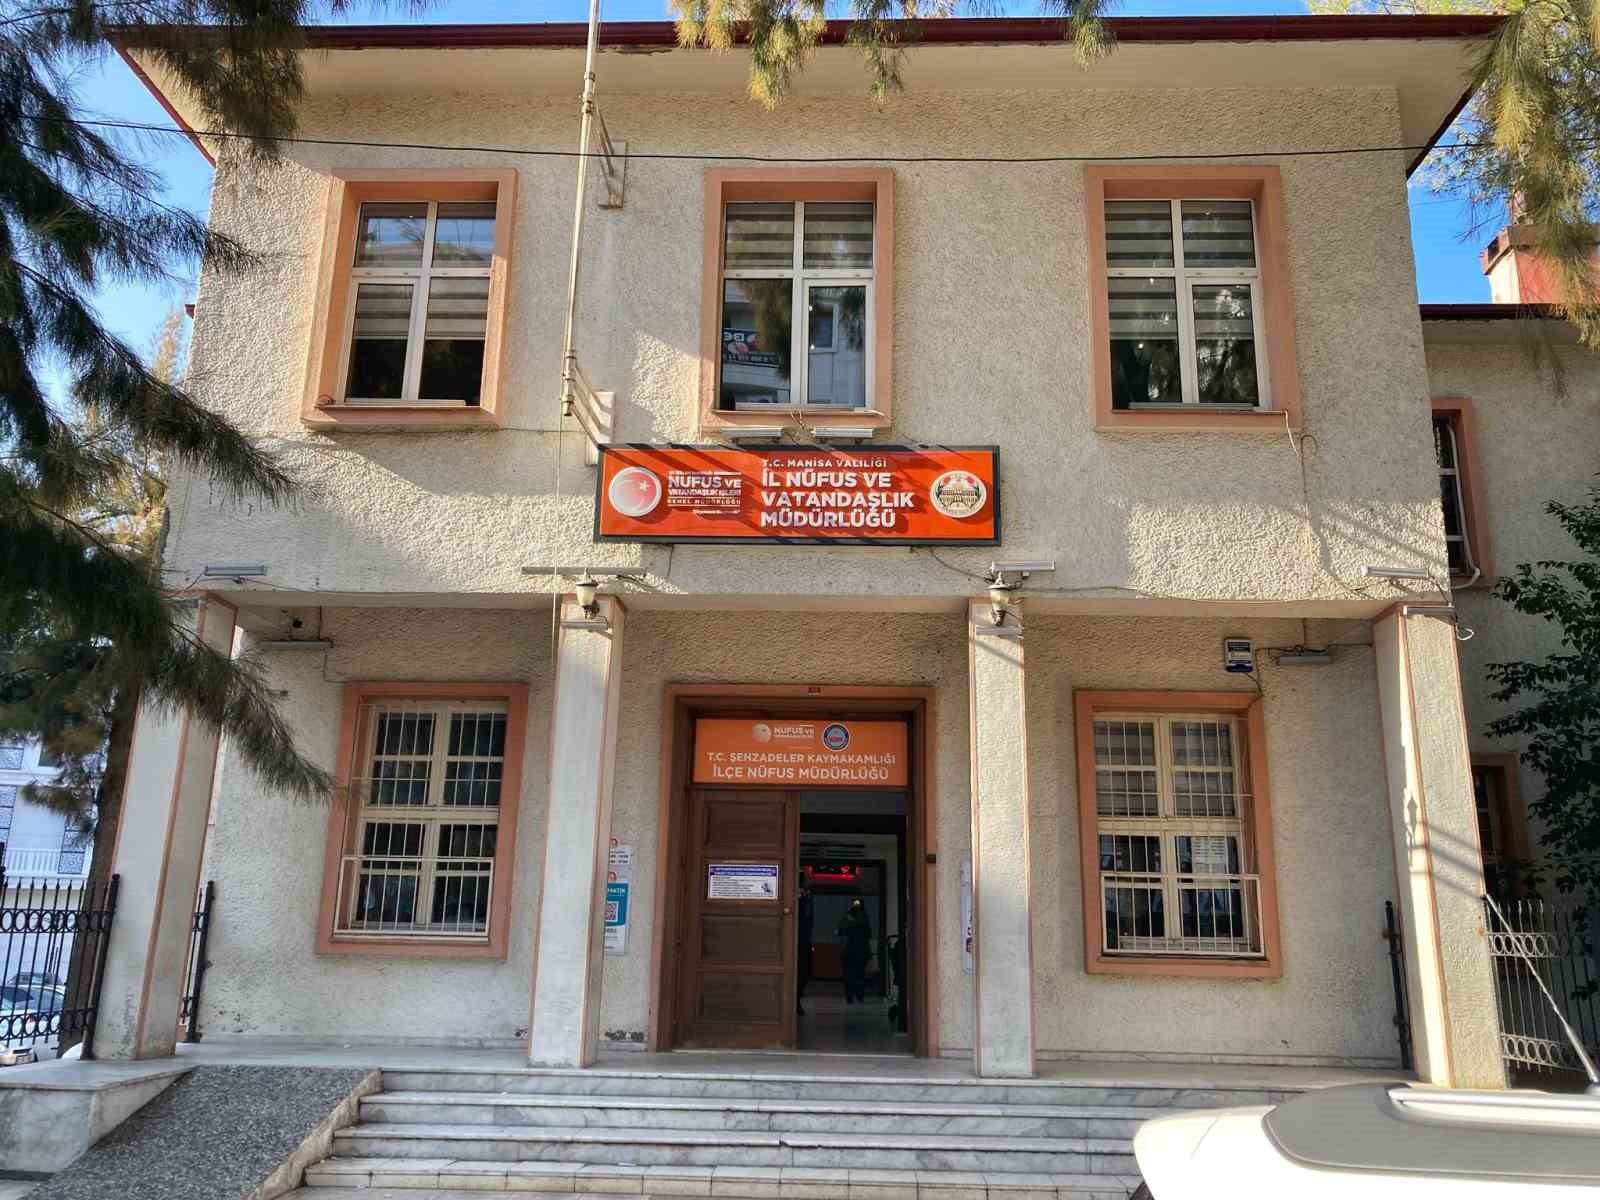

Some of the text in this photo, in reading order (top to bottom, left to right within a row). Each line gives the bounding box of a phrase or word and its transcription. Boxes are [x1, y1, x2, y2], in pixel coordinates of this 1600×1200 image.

[762, 458, 887, 468] T.C. MANİSA VALİLİĞİ
[724, 479, 742, 488] VE
[762, 469, 892, 488] İL NÜFUS VE
[761, 491, 915, 511] VATANDAŞLIK
[761, 508, 896, 528] MÜDÜRLÜĞÜ
[706, 751, 896, 765] T.C. ŞEHZADELER KAYMAKAMLIĞI
[713, 764, 889, 780] İLÇE NÜFUS MÜDÜRLÜĞÜ
